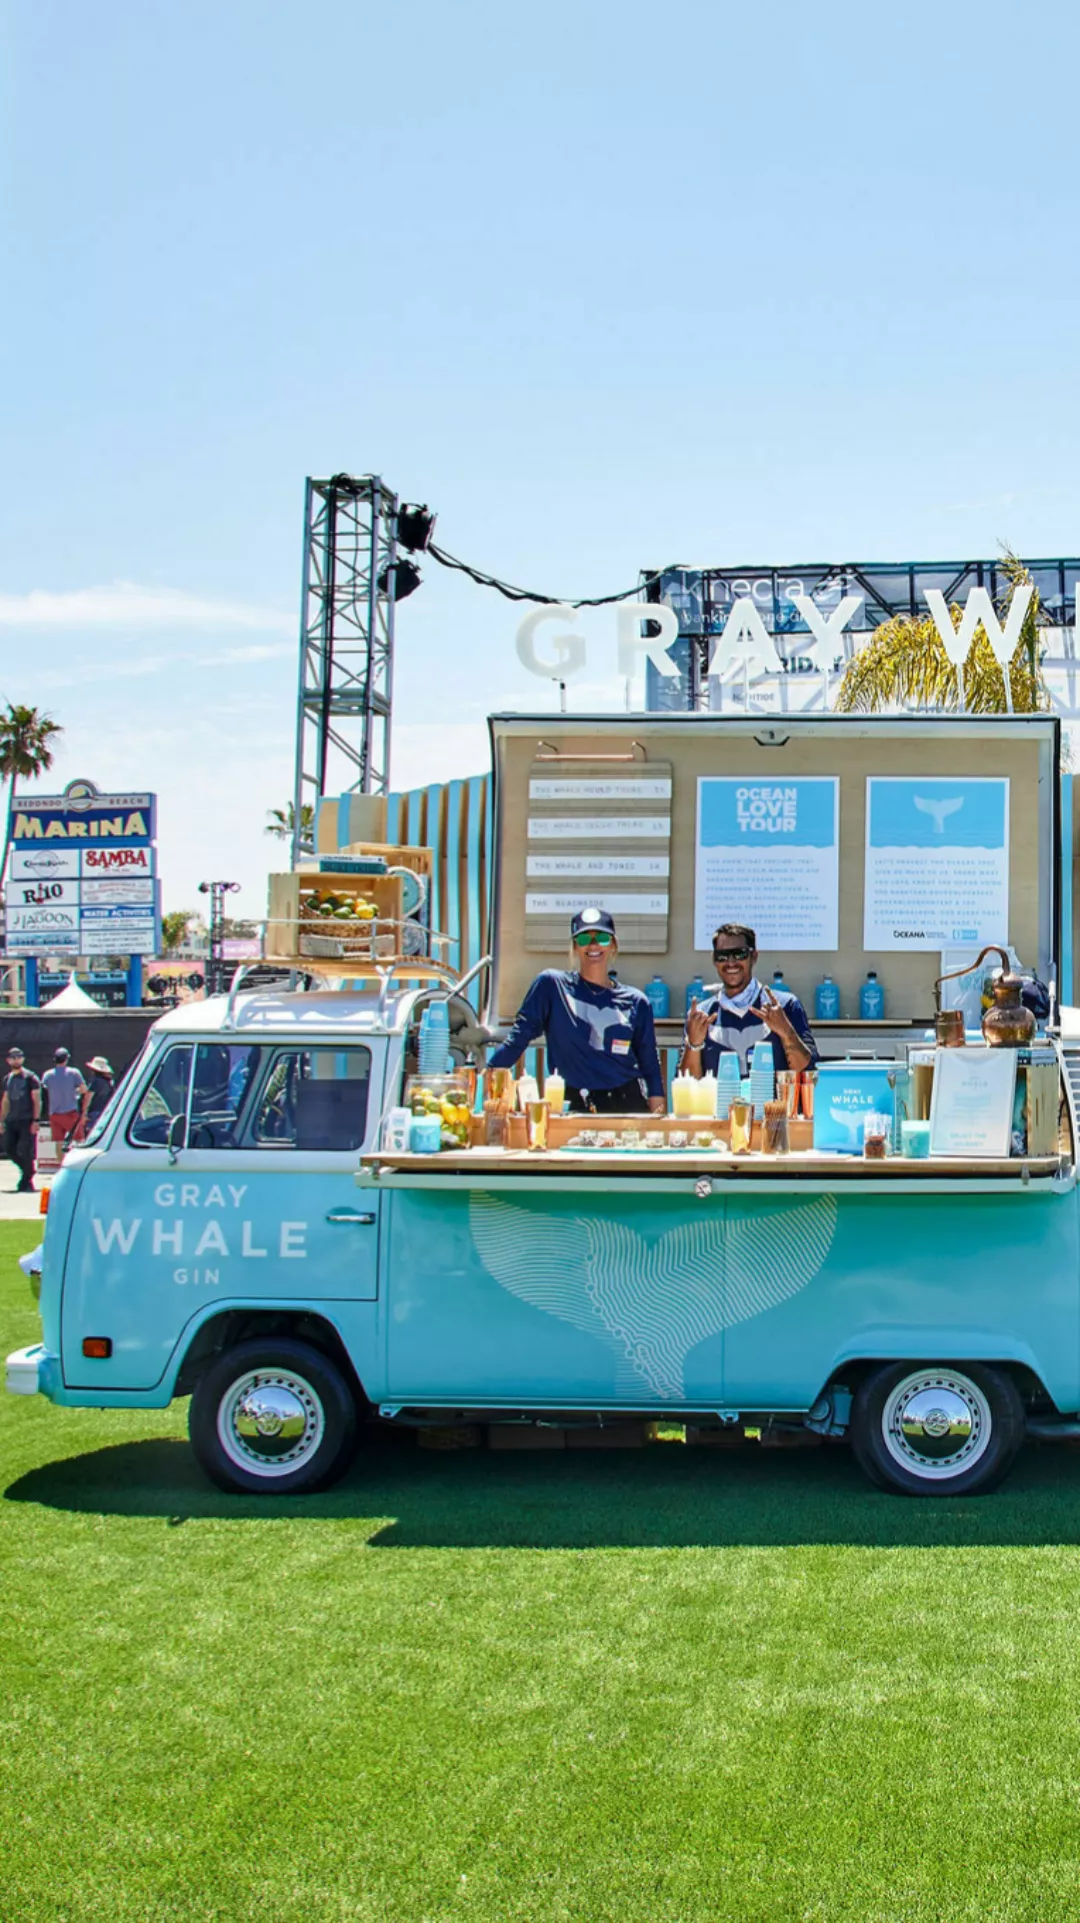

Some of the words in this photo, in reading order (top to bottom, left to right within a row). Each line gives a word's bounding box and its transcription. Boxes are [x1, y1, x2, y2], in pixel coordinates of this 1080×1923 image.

[682, 573, 805, 601] knecta
[516, 595, 864, 679] GRAY
[923, 582, 1080, 664] W
[736, 787, 797, 800] OCEAN
[17, 800, 62, 808] REDONDO
[109, 798, 145, 806] BEACH
[737, 800, 797, 816] LOVE
[13, 811, 148, 838] MARINA
[737, 817, 797, 832] TOUR
[86, 849, 148, 868] SAMBA
[893, 930, 925, 939] OCEANA
[832, 1095, 874, 1104] WHALE
[154, 1183, 249, 1208] GRAY
[91, 1218, 308, 1258] WHALE
[172, 1268, 221, 1285] GIN
